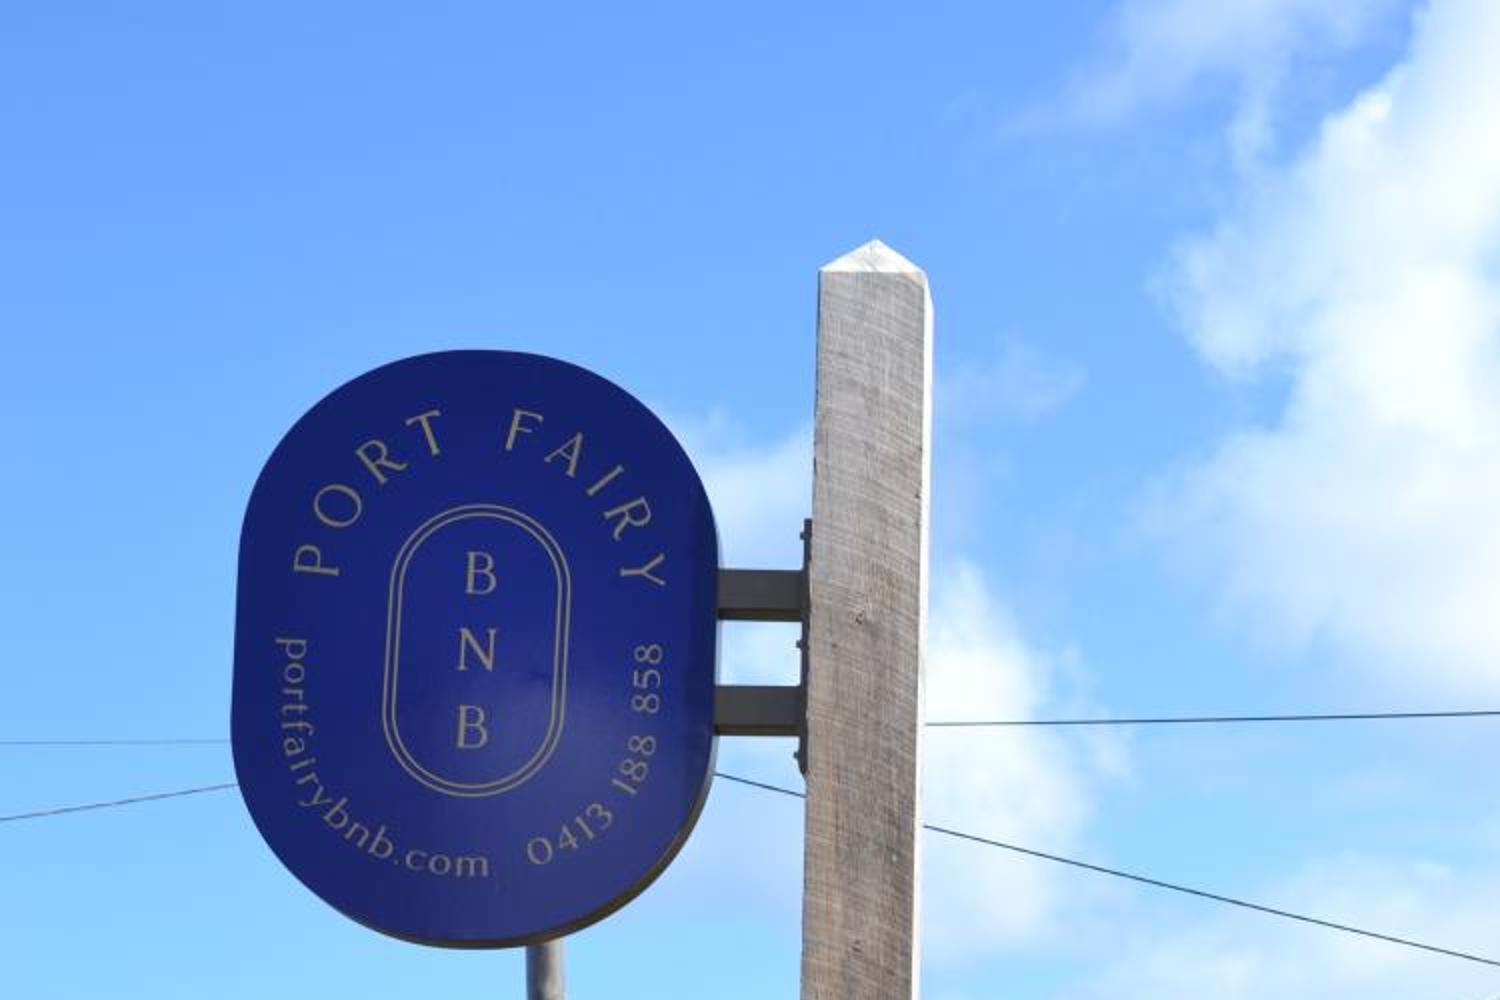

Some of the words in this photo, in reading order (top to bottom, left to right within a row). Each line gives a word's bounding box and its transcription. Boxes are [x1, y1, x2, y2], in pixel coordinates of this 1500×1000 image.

[293, 408, 441, 578] PORT
[505, 408, 667, 587] FAIRY
[631, 642, 664, 714] 858
[274, 635, 490, 878] portfairybnb.com
[611, 734, 658, 797] 188
[526, 801, 614, 867] 0413
